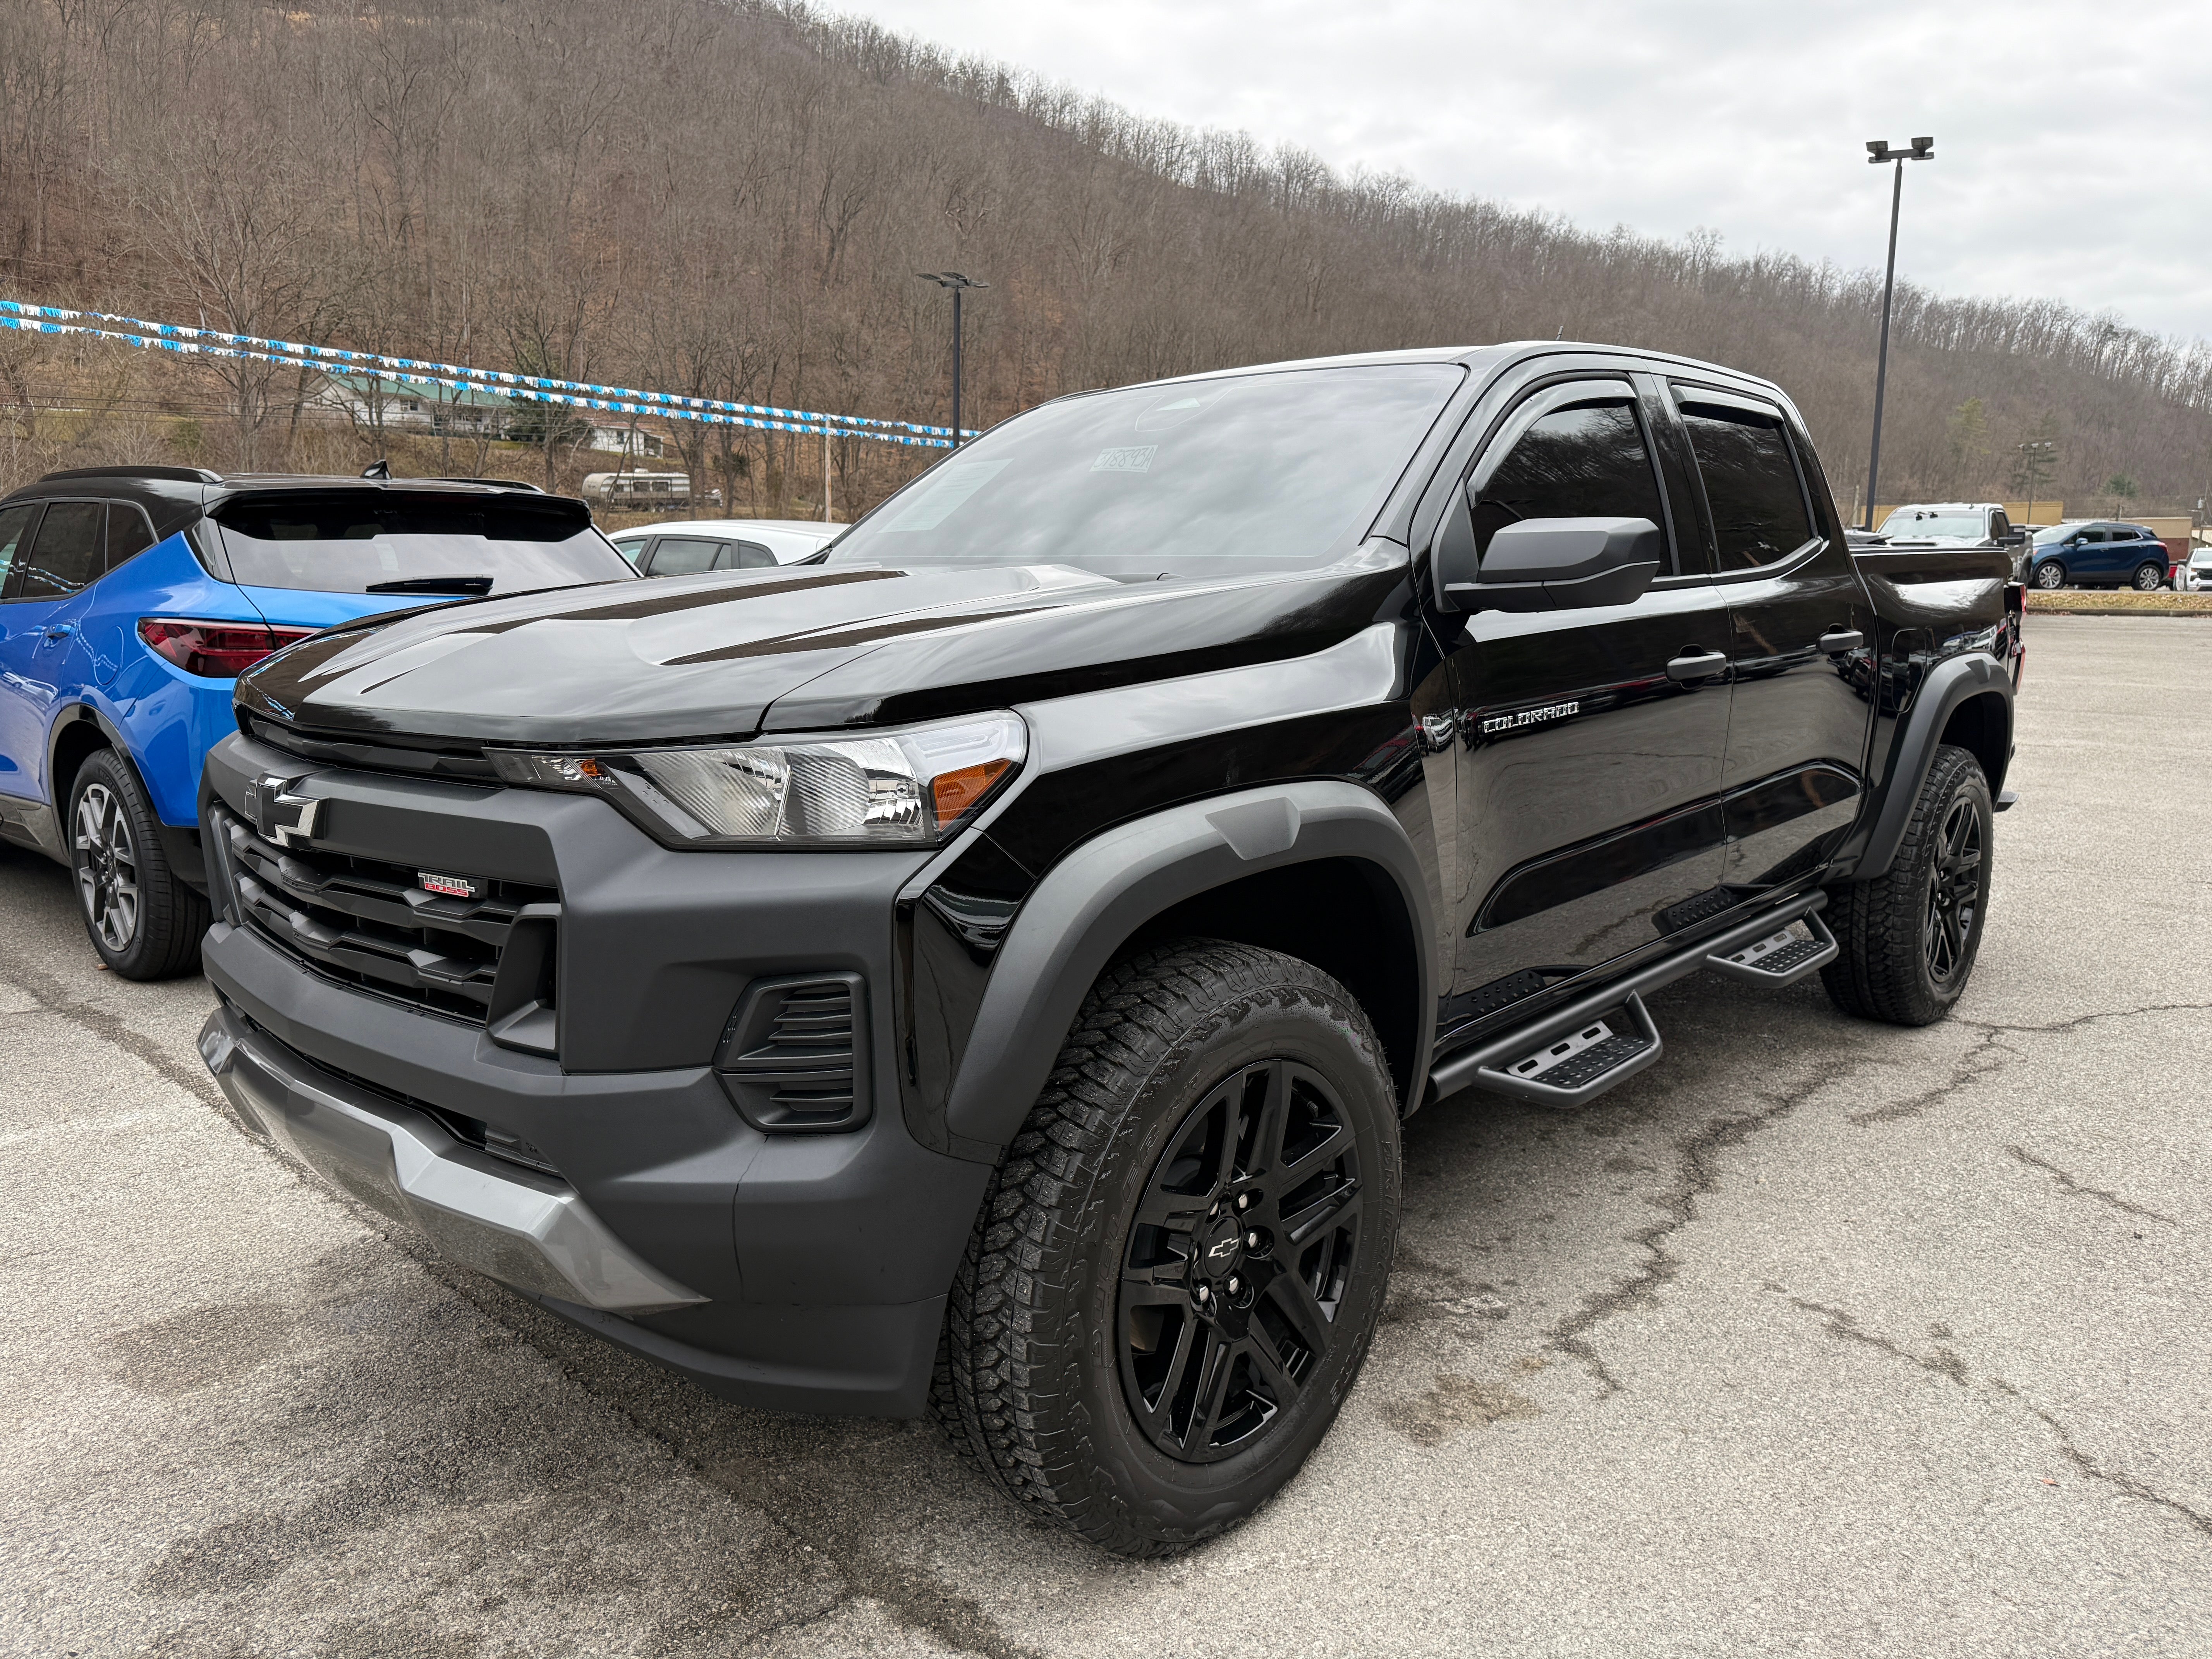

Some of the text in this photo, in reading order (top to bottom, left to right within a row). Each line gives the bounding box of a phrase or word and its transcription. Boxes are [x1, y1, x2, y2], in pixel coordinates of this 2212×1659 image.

[1093, 447, 1154, 468] 318893A
[1484, 701, 1579, 733] COLORADO
[418, 872, 475, 892] TRAIL
[425, 883, 469, 897] BOSS
[1330, 1141, 1393, 1406] BRIDGESTONE
